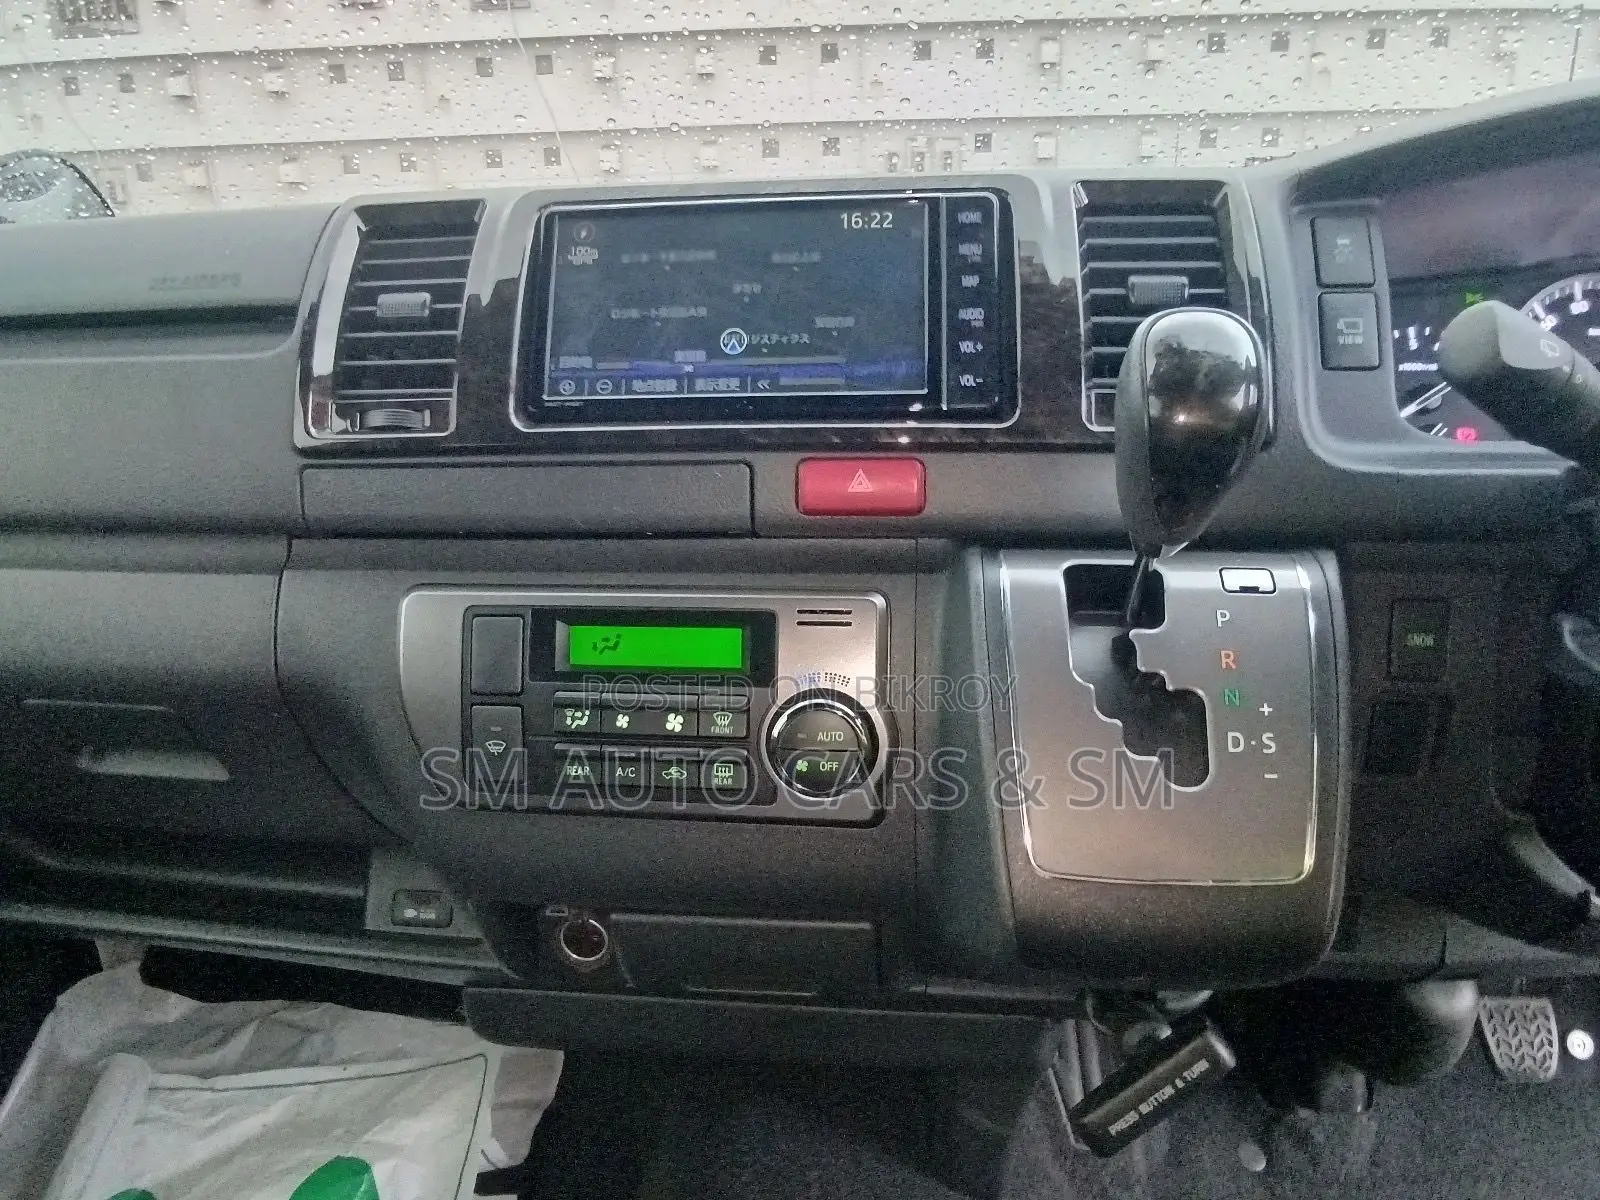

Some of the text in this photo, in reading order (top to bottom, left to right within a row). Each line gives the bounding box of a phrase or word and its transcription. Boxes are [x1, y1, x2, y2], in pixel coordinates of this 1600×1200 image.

[839, 211, 894, 230] 16:22
[957, 211, 983, 224] HOME
[961, 274, 980, 287] MAP
[958, 307, 985, 320] AUDIO
[1215, 609, 1231, 627] P
[1220, 650, 1237, 670] R
[1223, 689, 1241, 707] N
[710, 725, 734, 735] FRONT
[817, 731, 844, 742] AUTO
[566, 765, 590, 776] REAR
[615, 766, 636, 778] A/C
[819, 761, 839, 772] OFF
[714, 776, 733, 786] REAR
